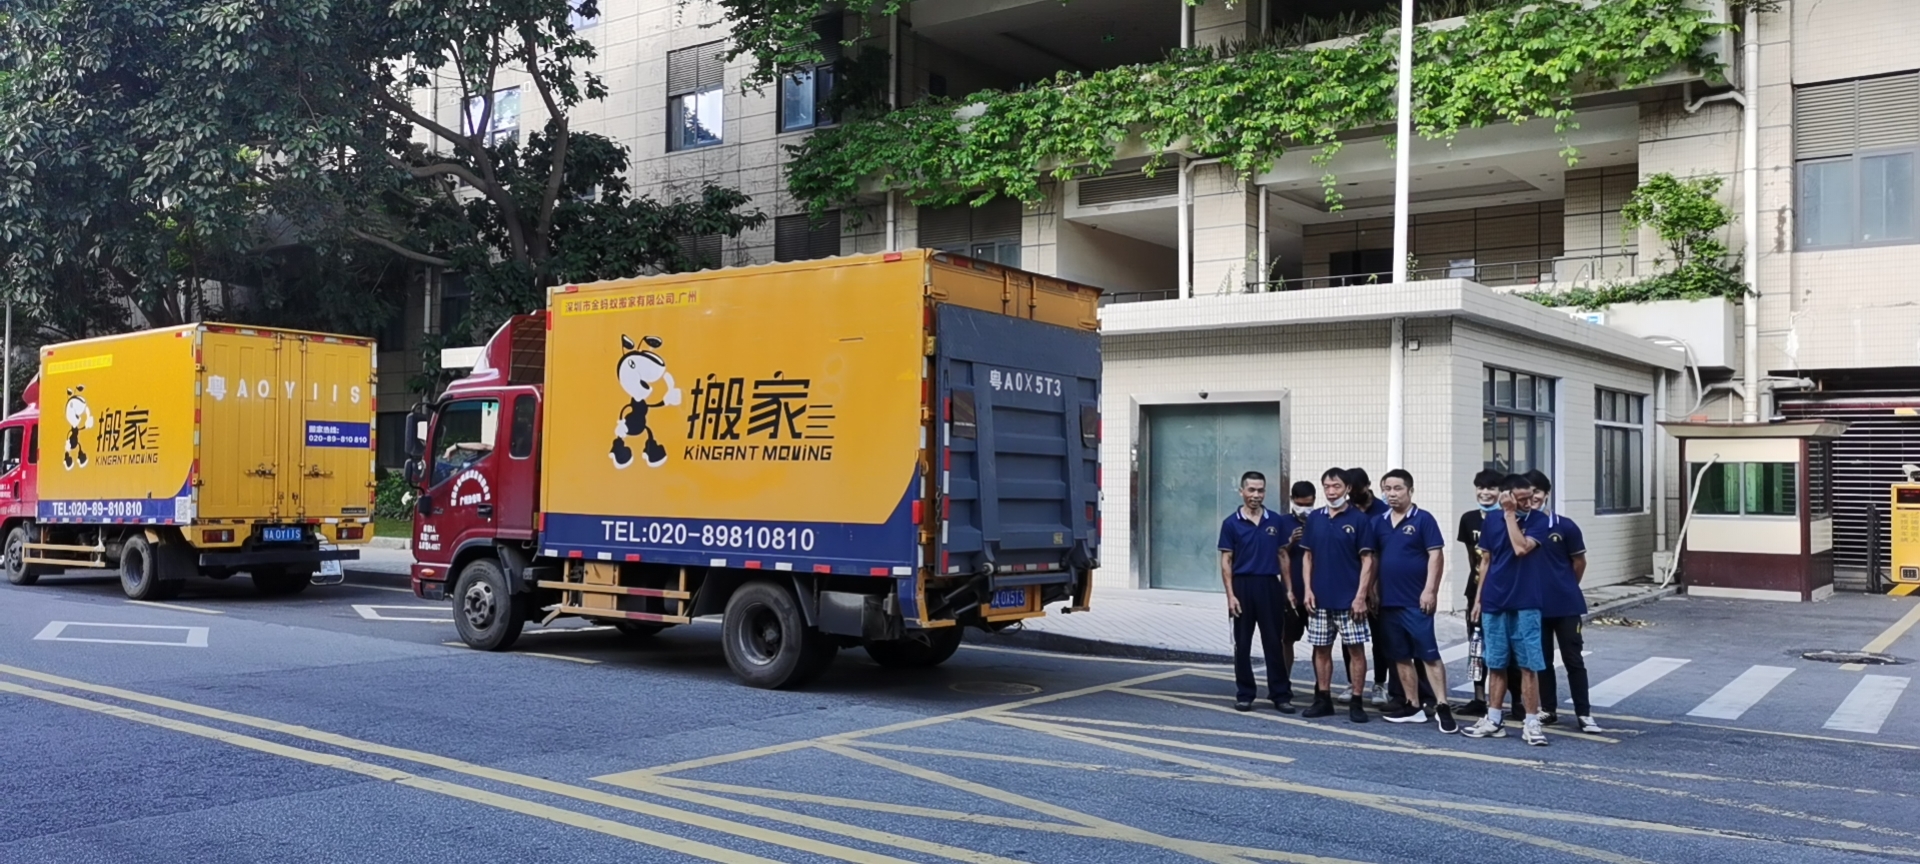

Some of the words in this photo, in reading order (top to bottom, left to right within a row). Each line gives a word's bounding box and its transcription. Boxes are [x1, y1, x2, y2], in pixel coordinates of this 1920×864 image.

[97, 405, 149, 452] 搬家
[687, 371, 810, 440] 搬家
[601, 520, 816, 551] TEL:020-89810810
